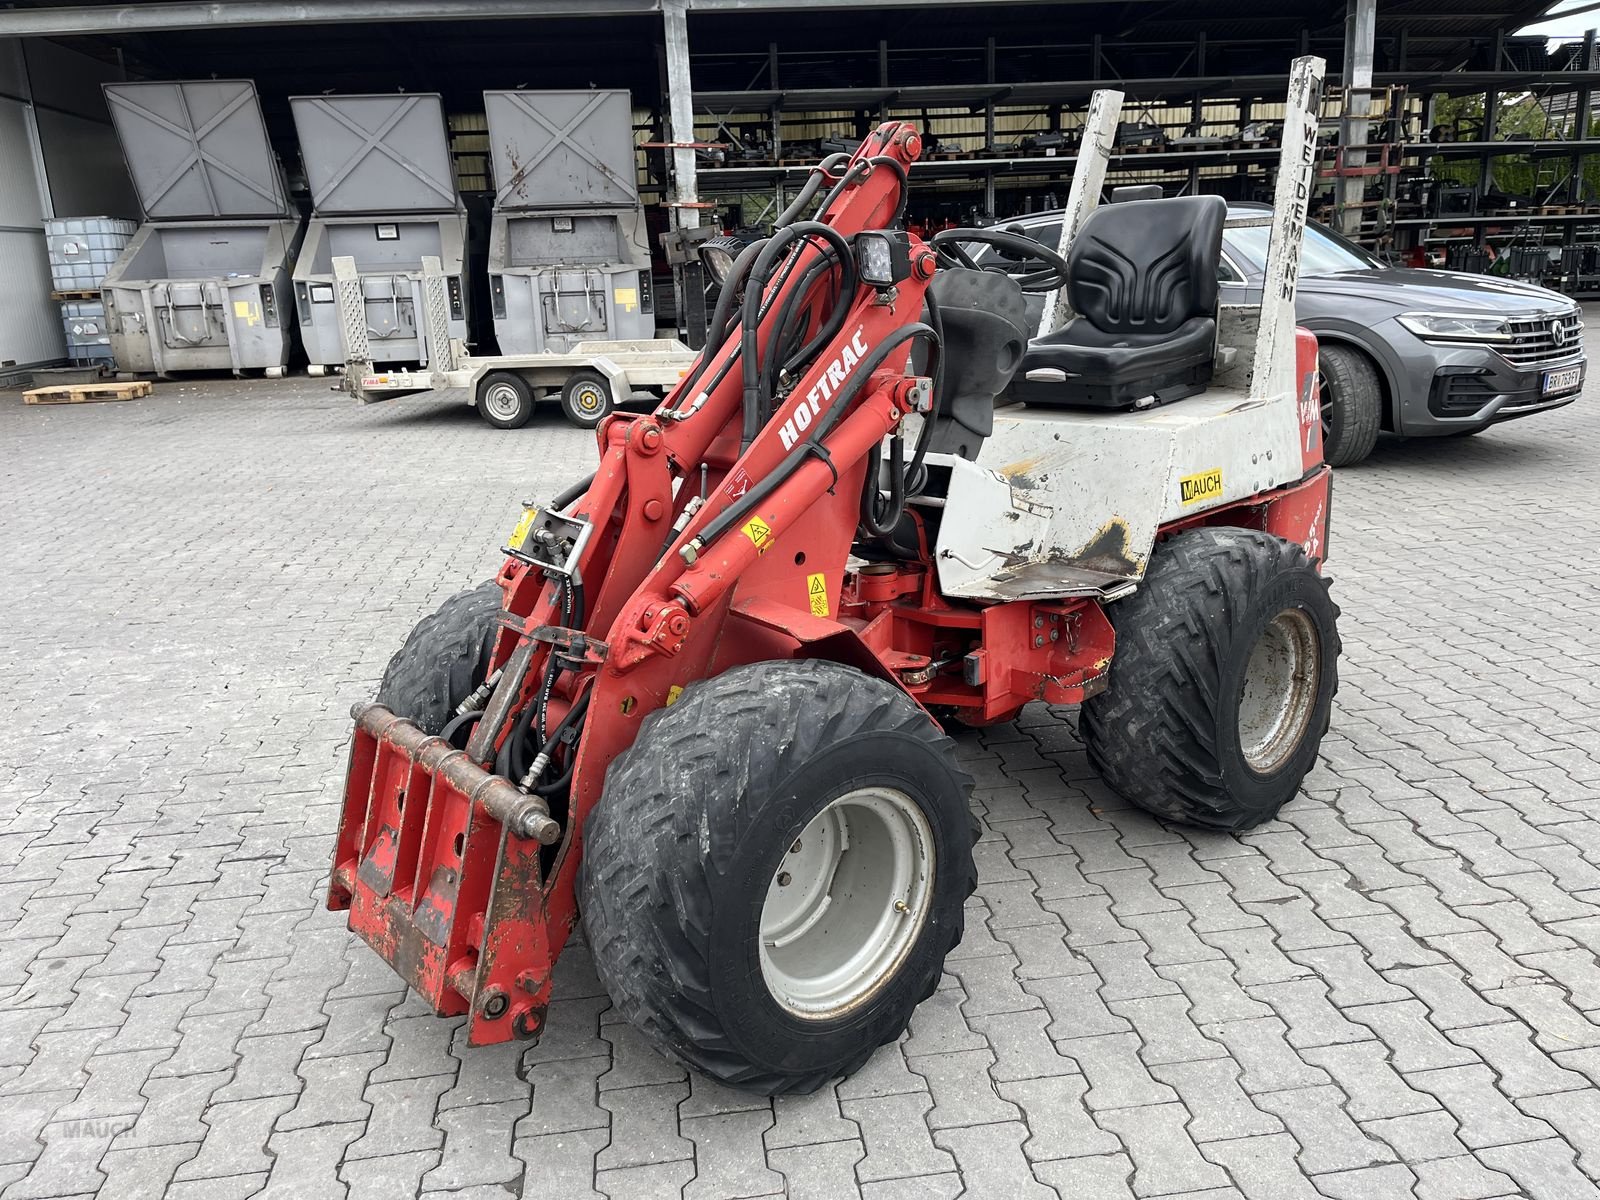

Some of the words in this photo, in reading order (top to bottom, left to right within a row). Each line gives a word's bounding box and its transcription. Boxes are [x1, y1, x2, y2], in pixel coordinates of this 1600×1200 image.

[1281, 122, 1317, 302] WEIDEMANN
[778, 329, 868, 451] HOFTRAC
[1180, 473, 1221, 502] MAUCH
